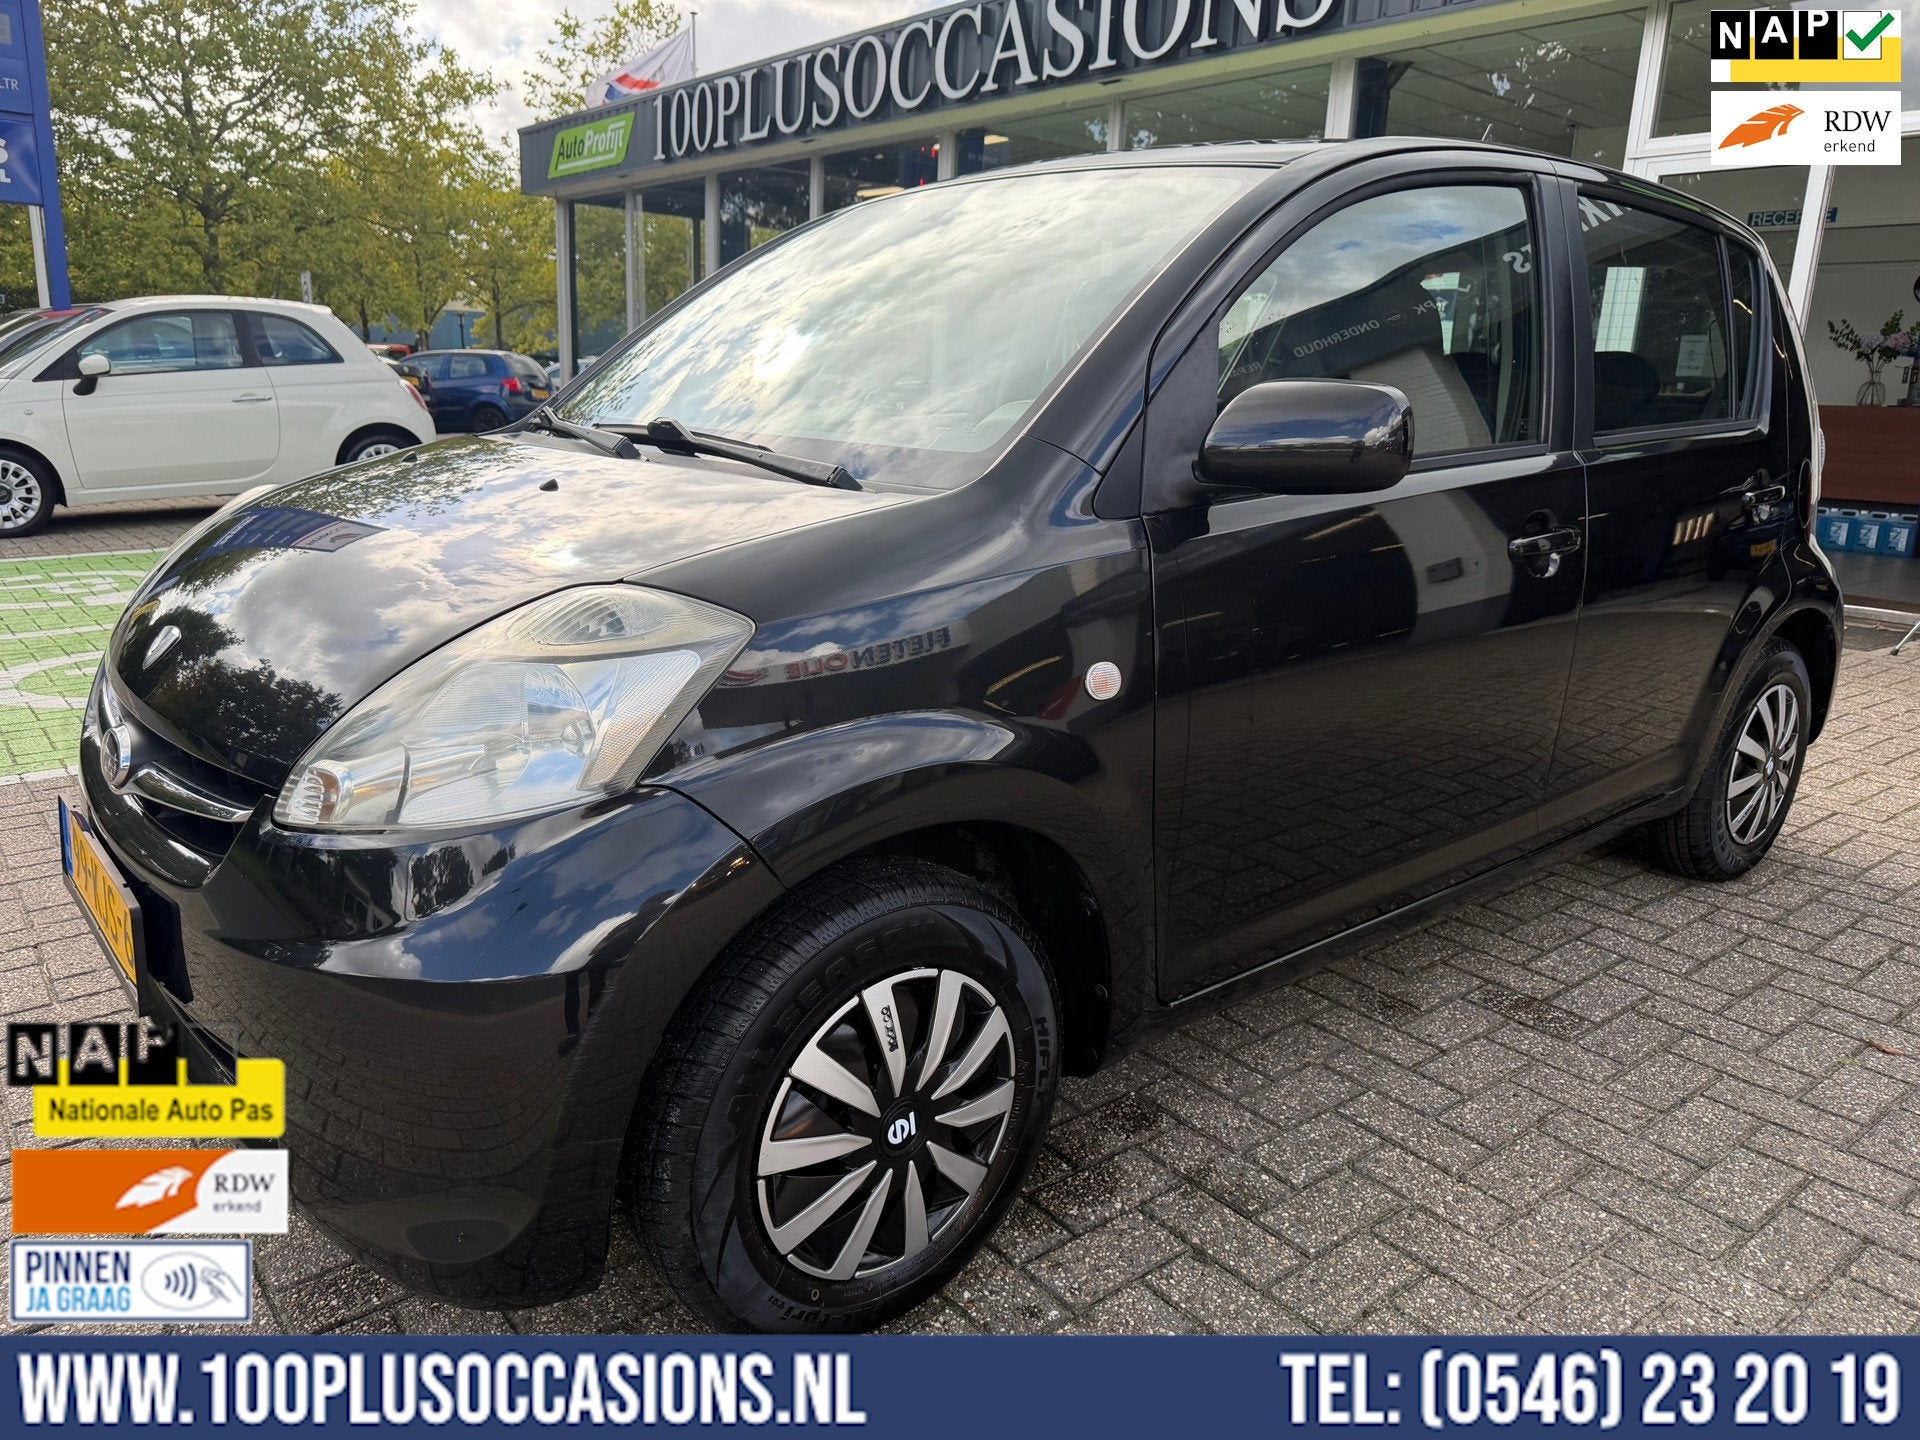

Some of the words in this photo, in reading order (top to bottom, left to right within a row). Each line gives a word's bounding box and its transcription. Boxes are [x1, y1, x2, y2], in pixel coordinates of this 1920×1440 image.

[555, 121, 625, 171] AutoProfijt
[651, 0, 1336, 161] 100PLUSOCCASIO
[72, 824, 135, 970] 99-KJS-6
